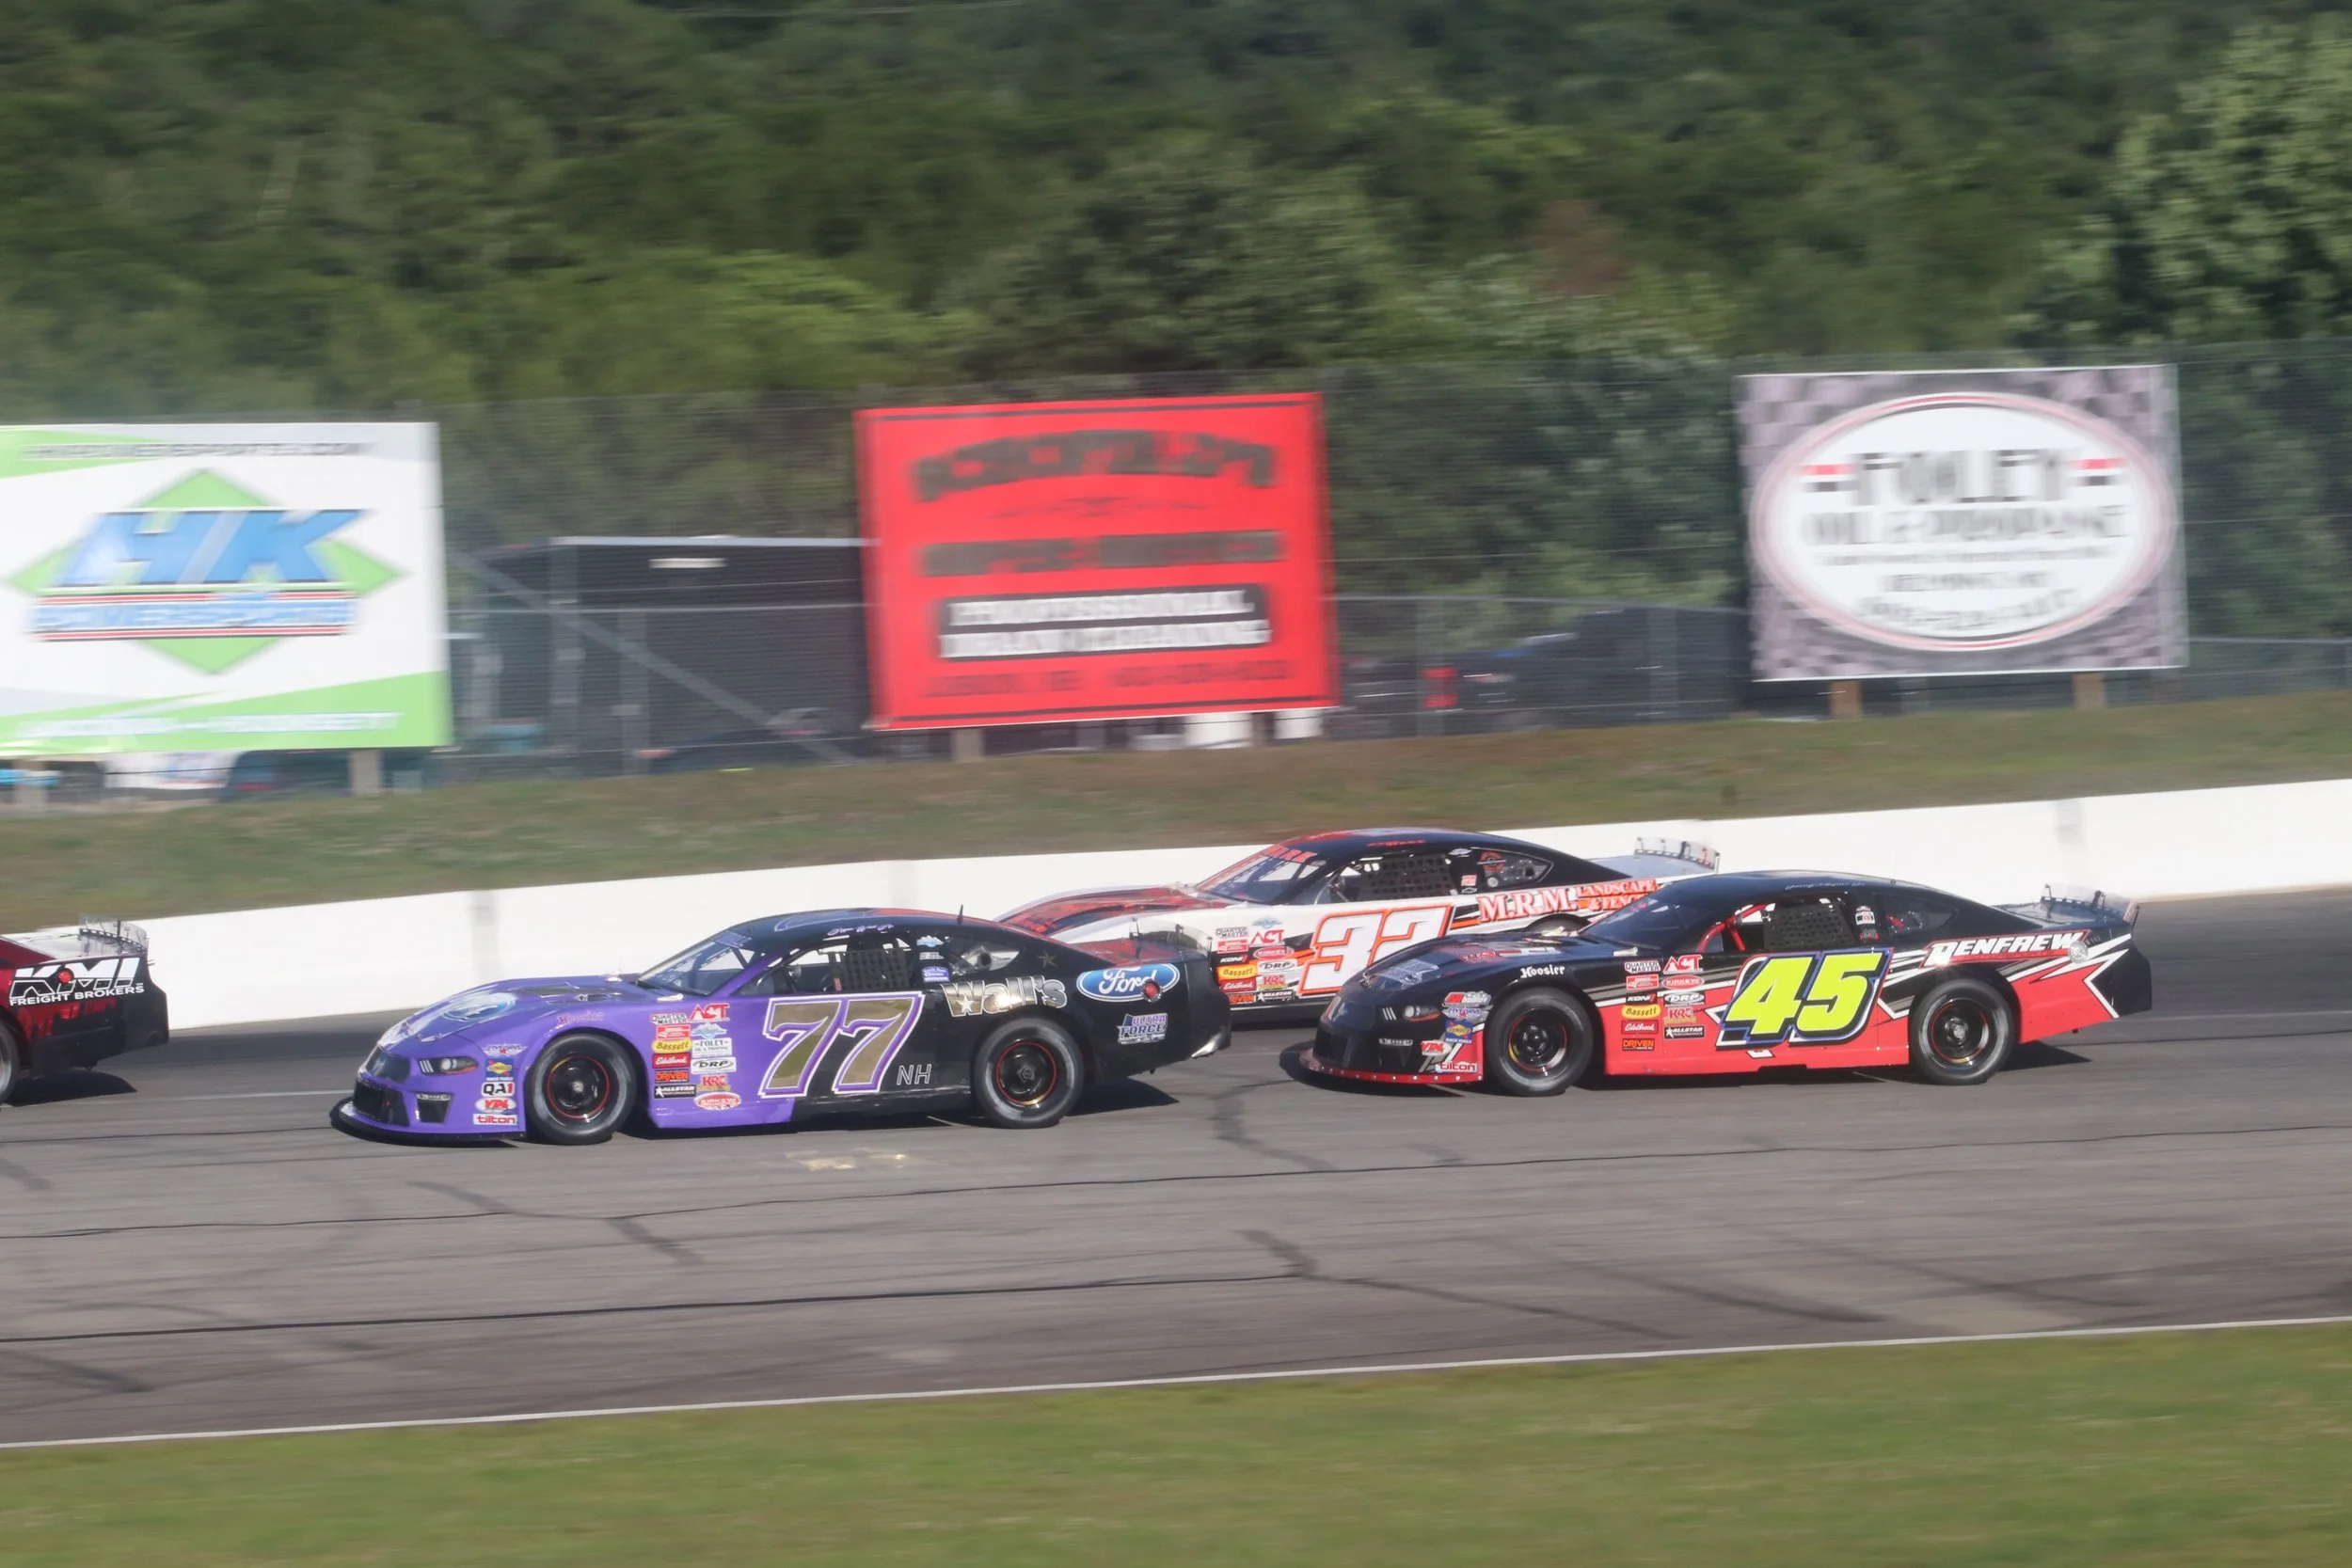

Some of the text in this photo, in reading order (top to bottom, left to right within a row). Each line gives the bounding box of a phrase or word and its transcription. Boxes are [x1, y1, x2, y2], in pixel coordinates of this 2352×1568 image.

[1576, 879, 1656, 897] LANDSCAPE
[1250, 929, 1285, 944] ACT
[1924, 931, 2084, 967] RENFREW
[1223, 967, 1253, 976] Bassett
[1520, 964, 1565, 979] Hoosier
[1664, 955, 1703, 973] ACT
[9, 957, 140, 999] KMI
[9, 985, 145, 1006] FREIGHT BROKERS
[940, 974, 1068, 1017] Wall's
[1671, 993, 1700, 1002] DRP
[1719, 949, 1890, 1044] 45
[690, 1003, 730, 1021] ACT
[1626, 1006, 1657, 1016] Bassett
[1120, 1024, 1164, 1037] FORCE
[657, 1041, 689, 1051] Bassett
[757, 990, 926, 1099] 77
[897, 1064, 931, 1085] NH
[483, 1083, 514, 1095] QA1
[476, 1115, 516, 1123] tilton
